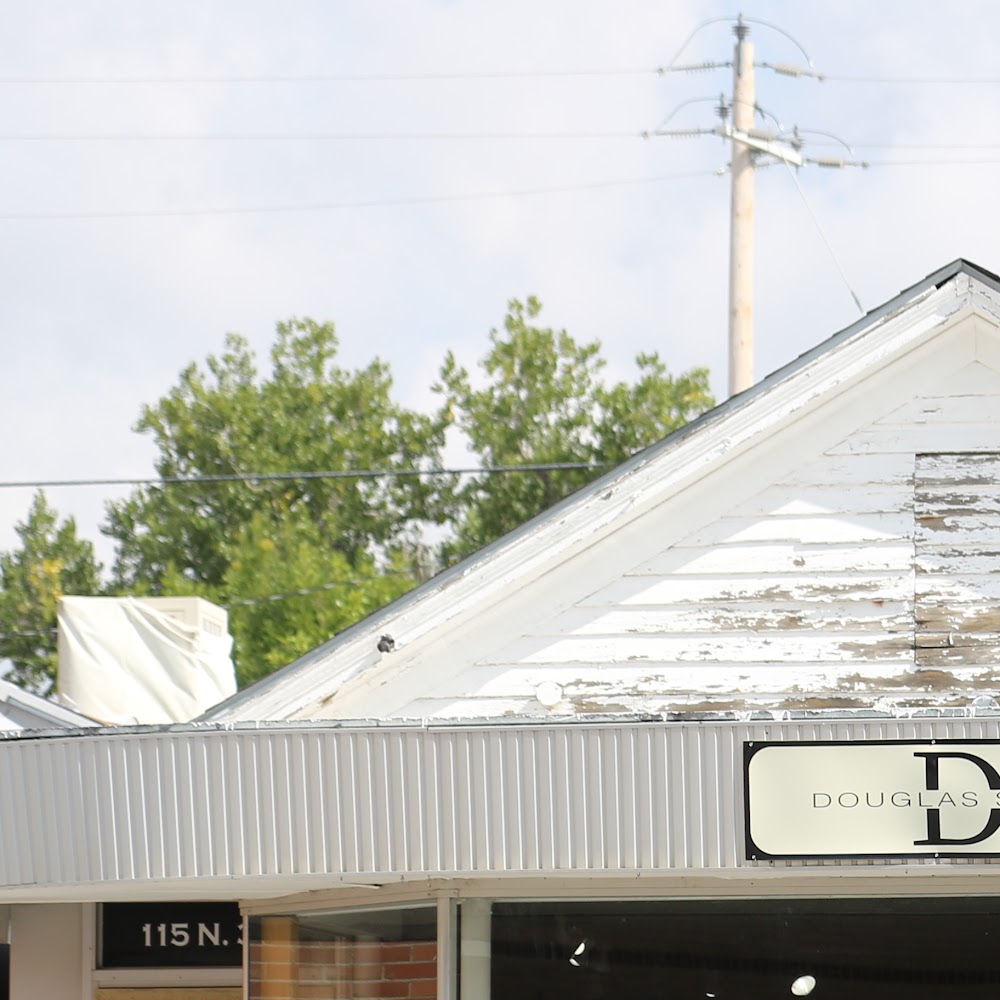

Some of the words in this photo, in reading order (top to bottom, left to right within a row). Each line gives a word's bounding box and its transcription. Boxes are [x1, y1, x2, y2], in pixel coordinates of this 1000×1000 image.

[812, 791, 979, 808] DOUGLAS
[142, 923, 190, 947] 115
[198, 922, 229, 947] N.
